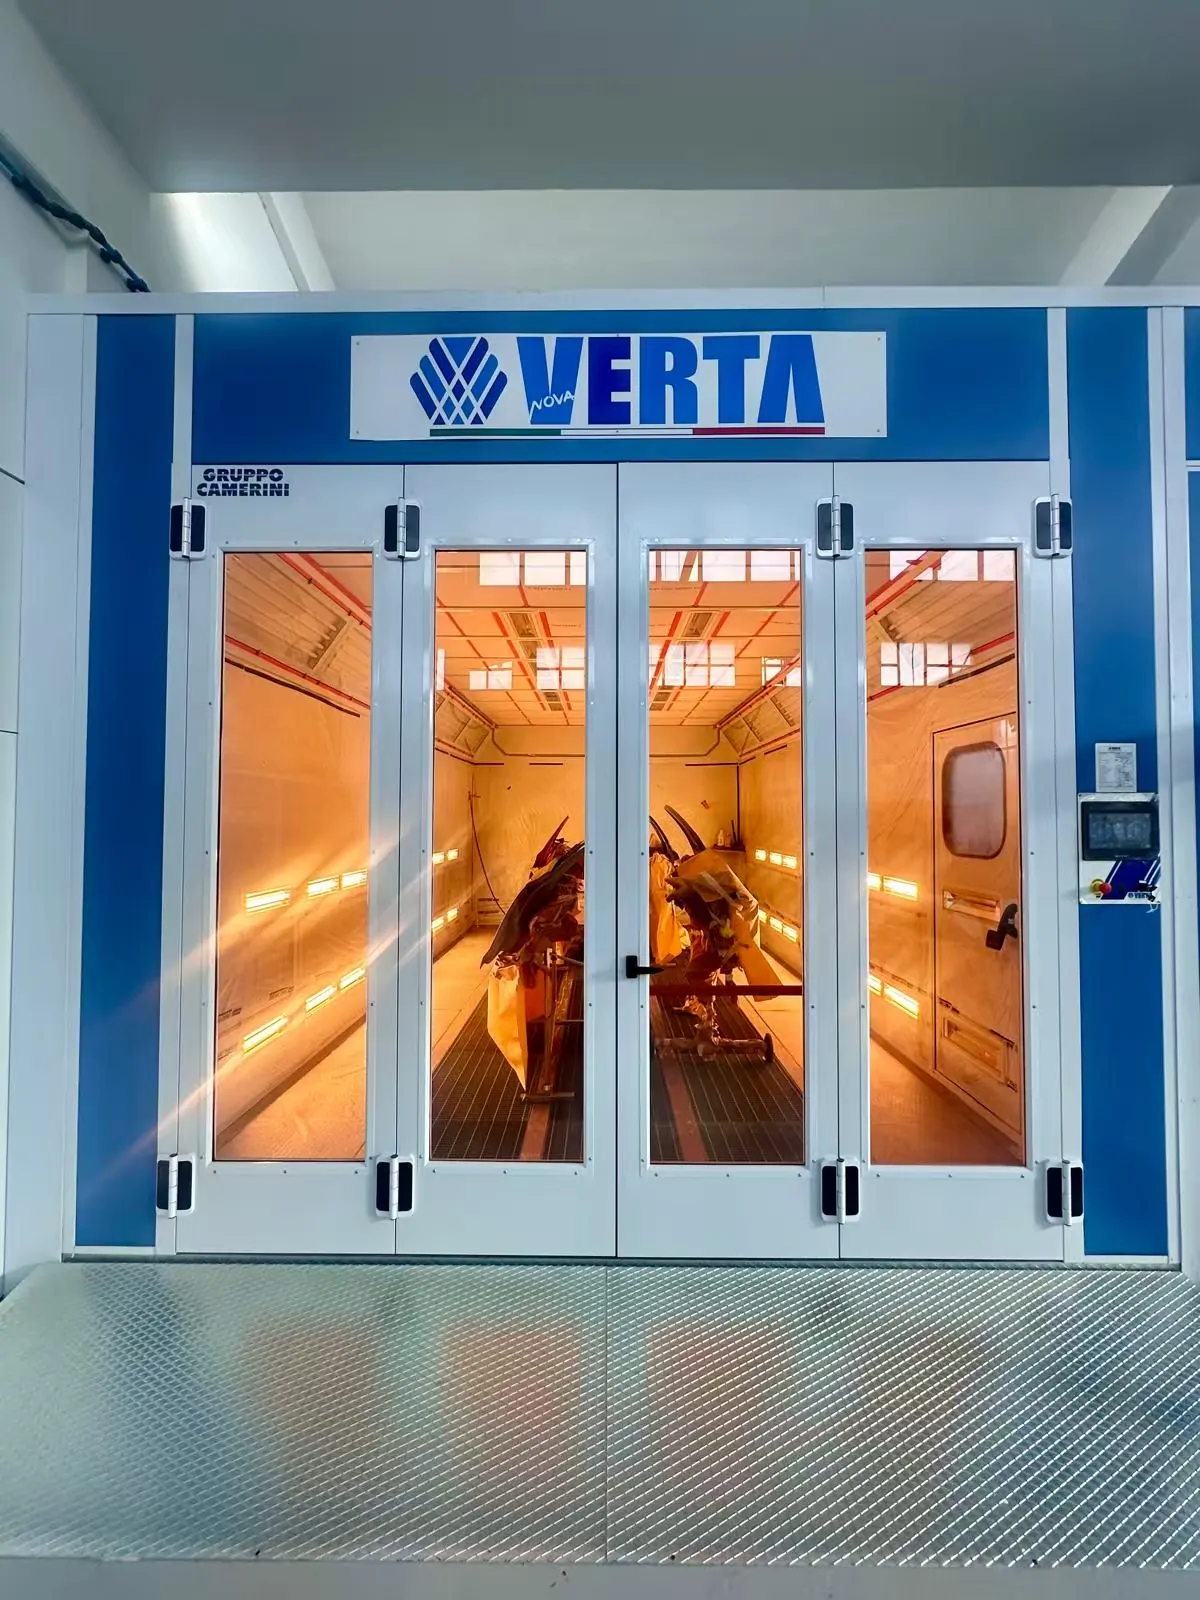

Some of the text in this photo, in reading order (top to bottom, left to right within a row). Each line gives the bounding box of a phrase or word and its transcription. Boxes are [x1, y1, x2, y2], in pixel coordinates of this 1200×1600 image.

[516, 334, 825, 425] VERTA
[529, 390, 575, 421] NOVA
[203, 468, 283, 482] GRUPPO
[197, 483, 289, 496] CAMERINI
